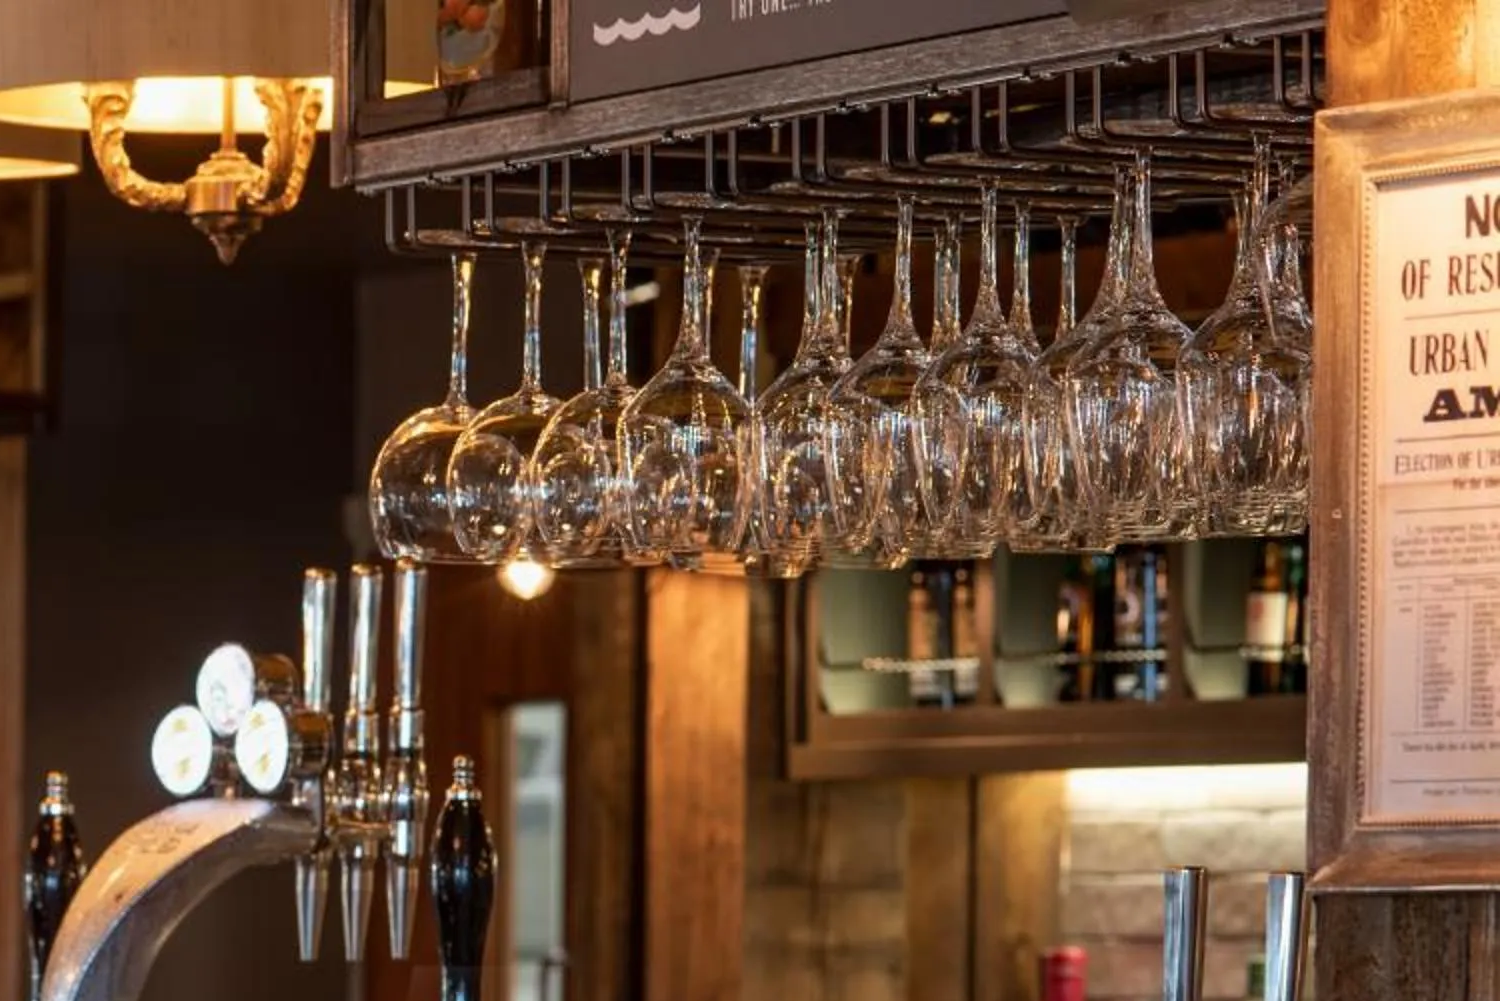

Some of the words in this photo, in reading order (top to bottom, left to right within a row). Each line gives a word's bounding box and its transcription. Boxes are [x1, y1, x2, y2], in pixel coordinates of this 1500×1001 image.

[1401, 259, 1431, 301] OF
[1447, 250, 1500, 297] RES
[1408, 328, 1489, 376] URBAN
[1457, 451, 1473, 470] OF
